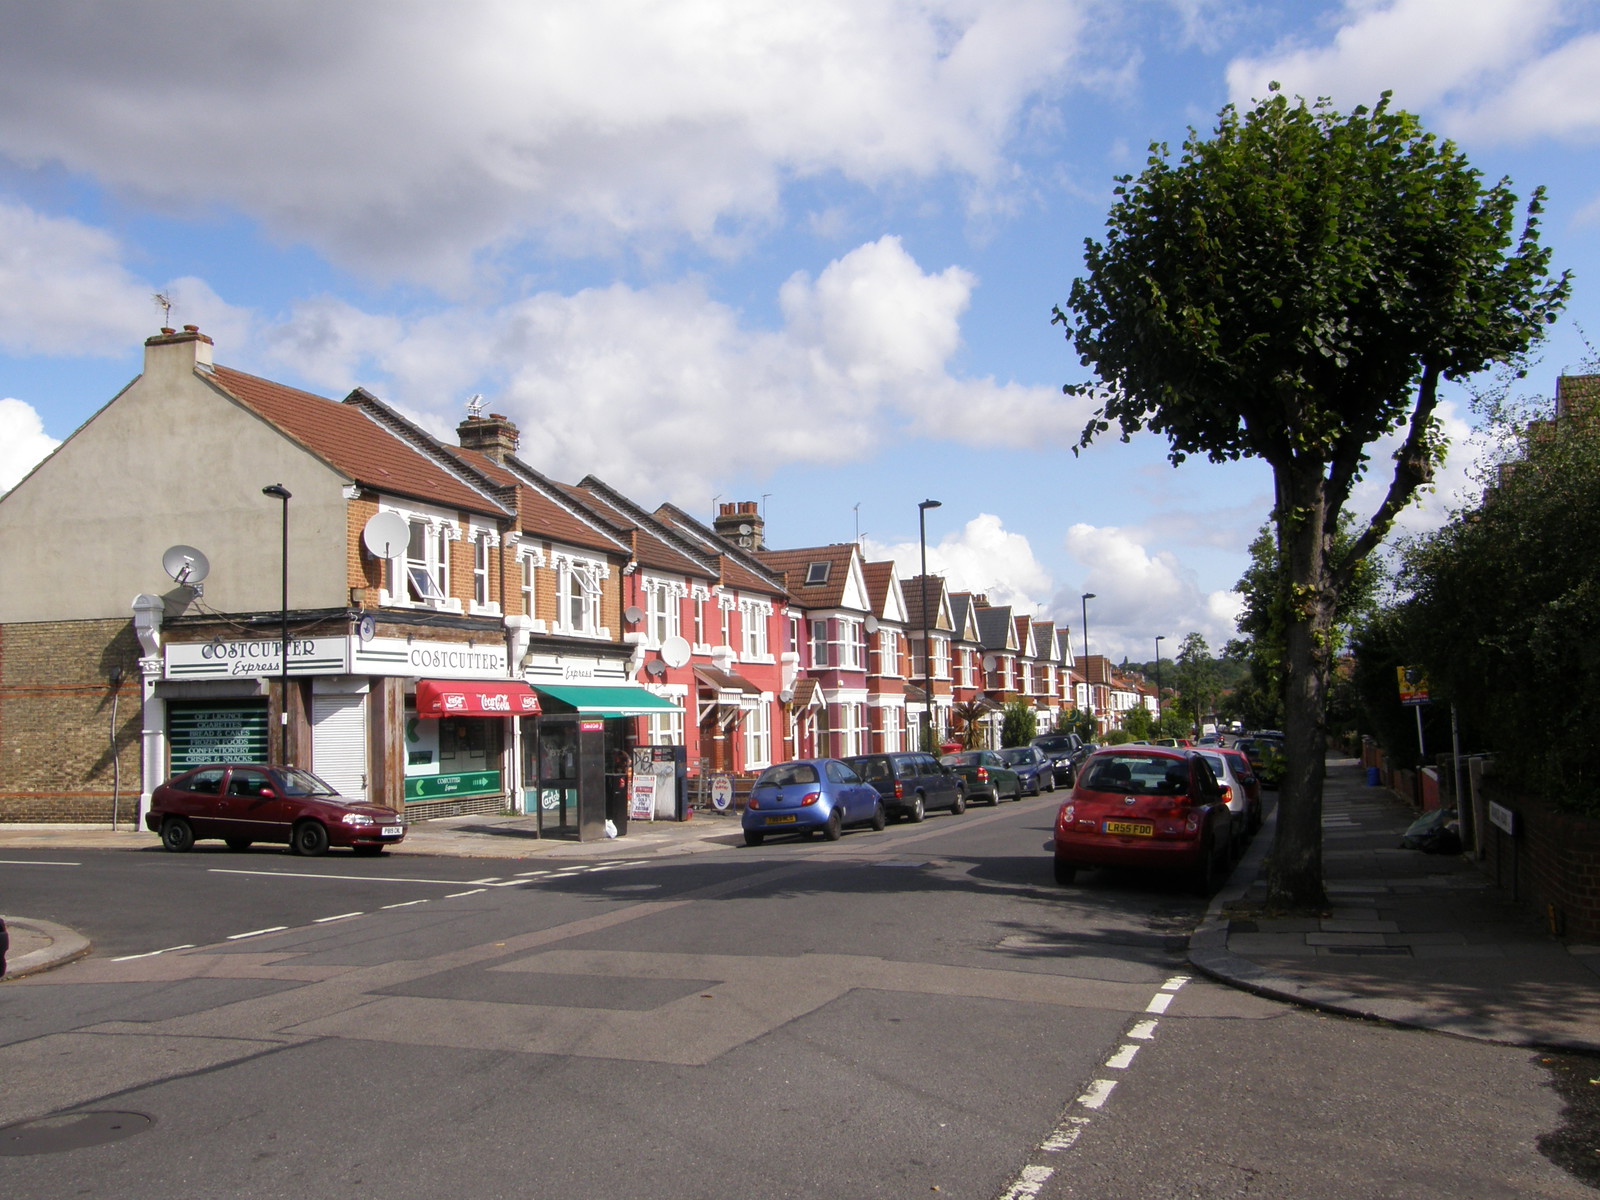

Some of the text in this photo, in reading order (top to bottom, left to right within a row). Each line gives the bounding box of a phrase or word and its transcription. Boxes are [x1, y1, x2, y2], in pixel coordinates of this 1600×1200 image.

[202, 640, 315, 659] COSTCUTTER
[411, 649, 498, 671] COSTCUTTER
[232, 661, 280, 676] Express
[565, 665, 592, 680] Express
[212, 712, 243, 720] LICENCE
[225, 729, 250, 737] CAKES
[1107, 822, 1132, 833] LR55
